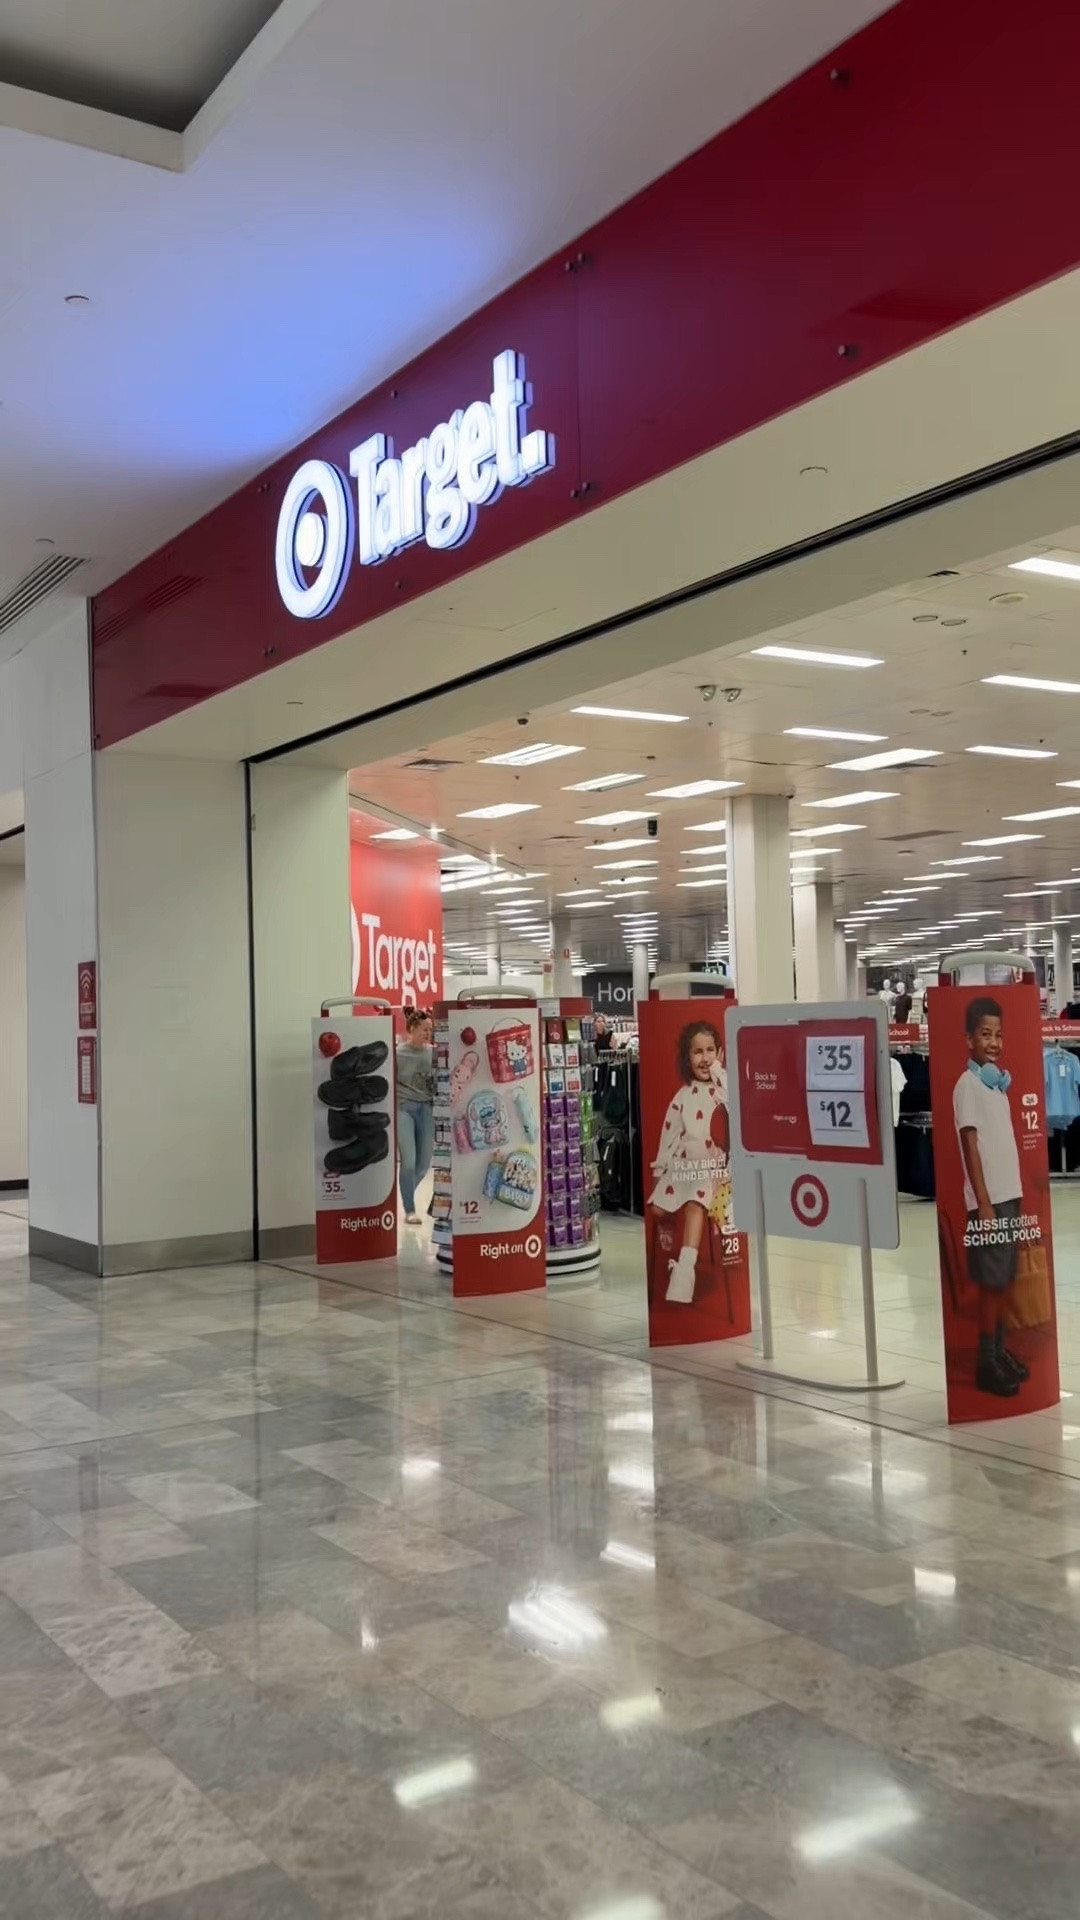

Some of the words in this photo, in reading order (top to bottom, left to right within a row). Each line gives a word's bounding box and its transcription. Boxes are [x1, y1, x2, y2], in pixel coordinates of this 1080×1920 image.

[817, 1045, 852, 1071] $35
[755, 1072, 769, 1081] Back
[770, 1072, 777, 1081] to
[756, 1081, 776, 1090] School
[820, 1101, 853, 1128] $12
[674, 1159, 699, 1170] PLAY
[701, 1158, 716, 1169] BIG
[672, 1169, 709, 1181] KINDER
[711, 1167, 728, 1179] FITS
[340, 1216, 367, 1232] Right
[368, 1217, 379, 1227] on
[966, 1217, 1008, 1233] AUSSIE
[1010, 1213, 1038, 1228] cotton
[963, 1232, 1010, 1247] SCHOOL
[1013, 1227, 1042, 1242] POLOS
[480, 1243, 509, 1259] Right
[511, 1243, 523, 1254] on
